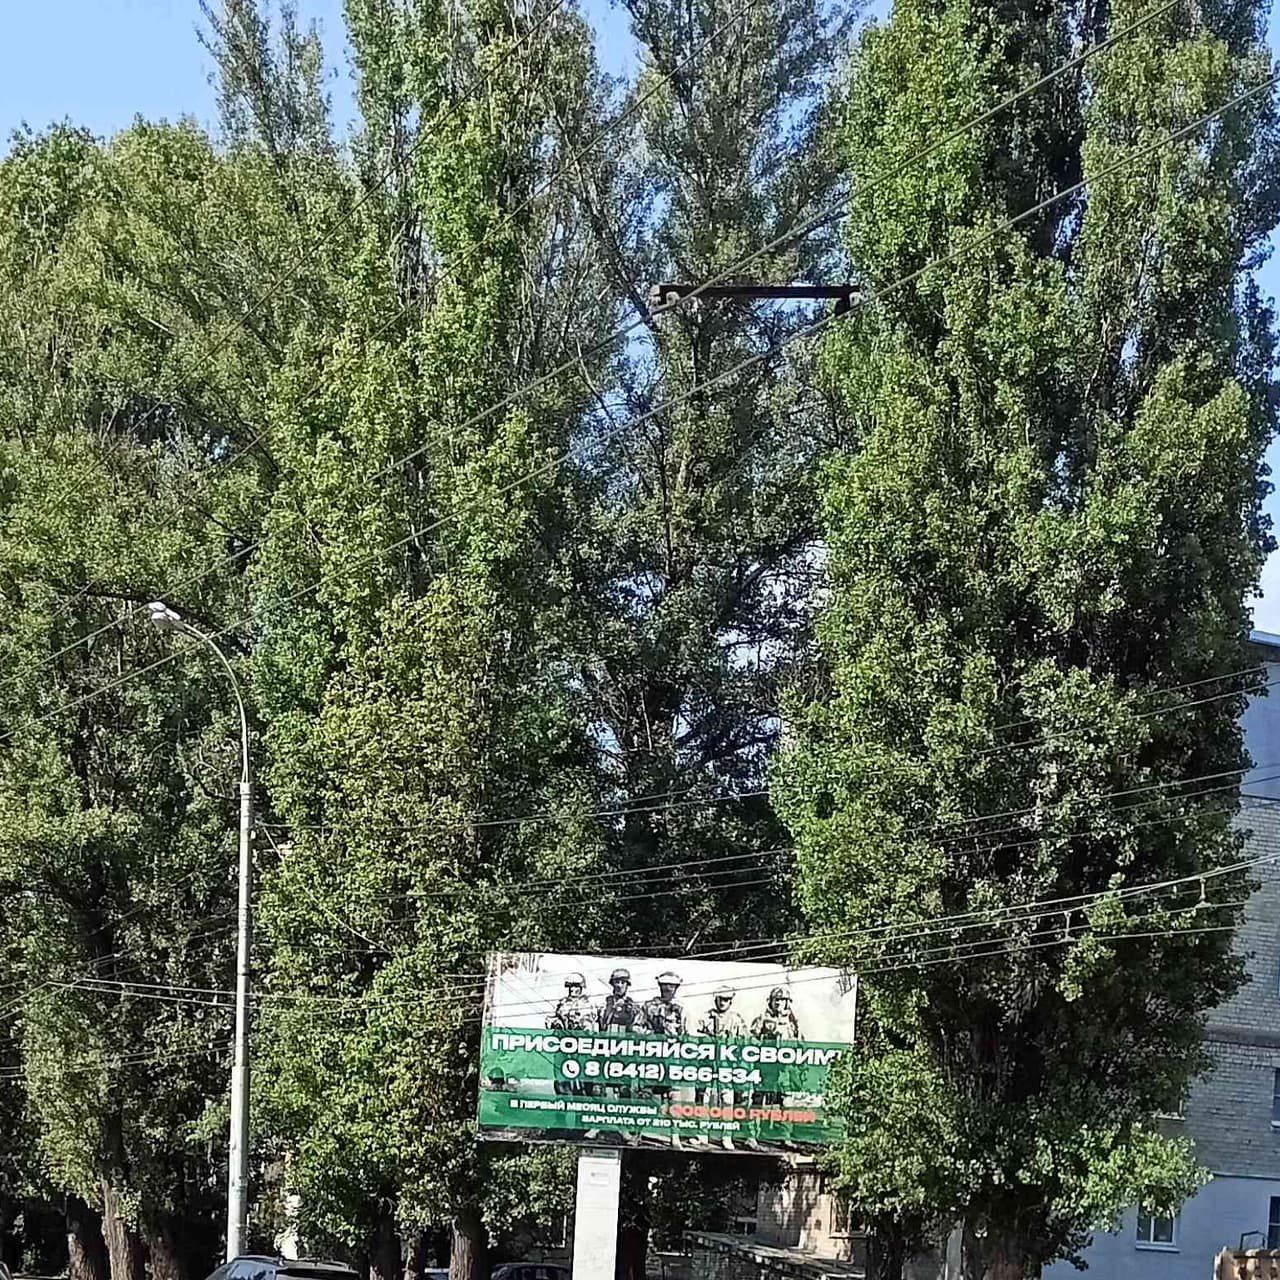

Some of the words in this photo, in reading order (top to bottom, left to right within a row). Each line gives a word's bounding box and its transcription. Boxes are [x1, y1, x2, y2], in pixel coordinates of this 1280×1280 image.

[492, 1033, 715, 1061] ПРИСОЕДИНЯЙСЯ
[721, 1044, 738, 1062] К
[584, 1060, 601, 1077] 8
[669, 1065, 762, 1085] 566-534
[519, 1099, 566, 1111] ПЕРВЫЙ
[566, 1101, 606, 1114] МЕСЯЦ
[606, 1103, 658, 1116] СЛУЖБЫ
[581, 1115, 636, 1126] ЗАРПЛАТА
[636, 1117, 652, 1127] ОТ
